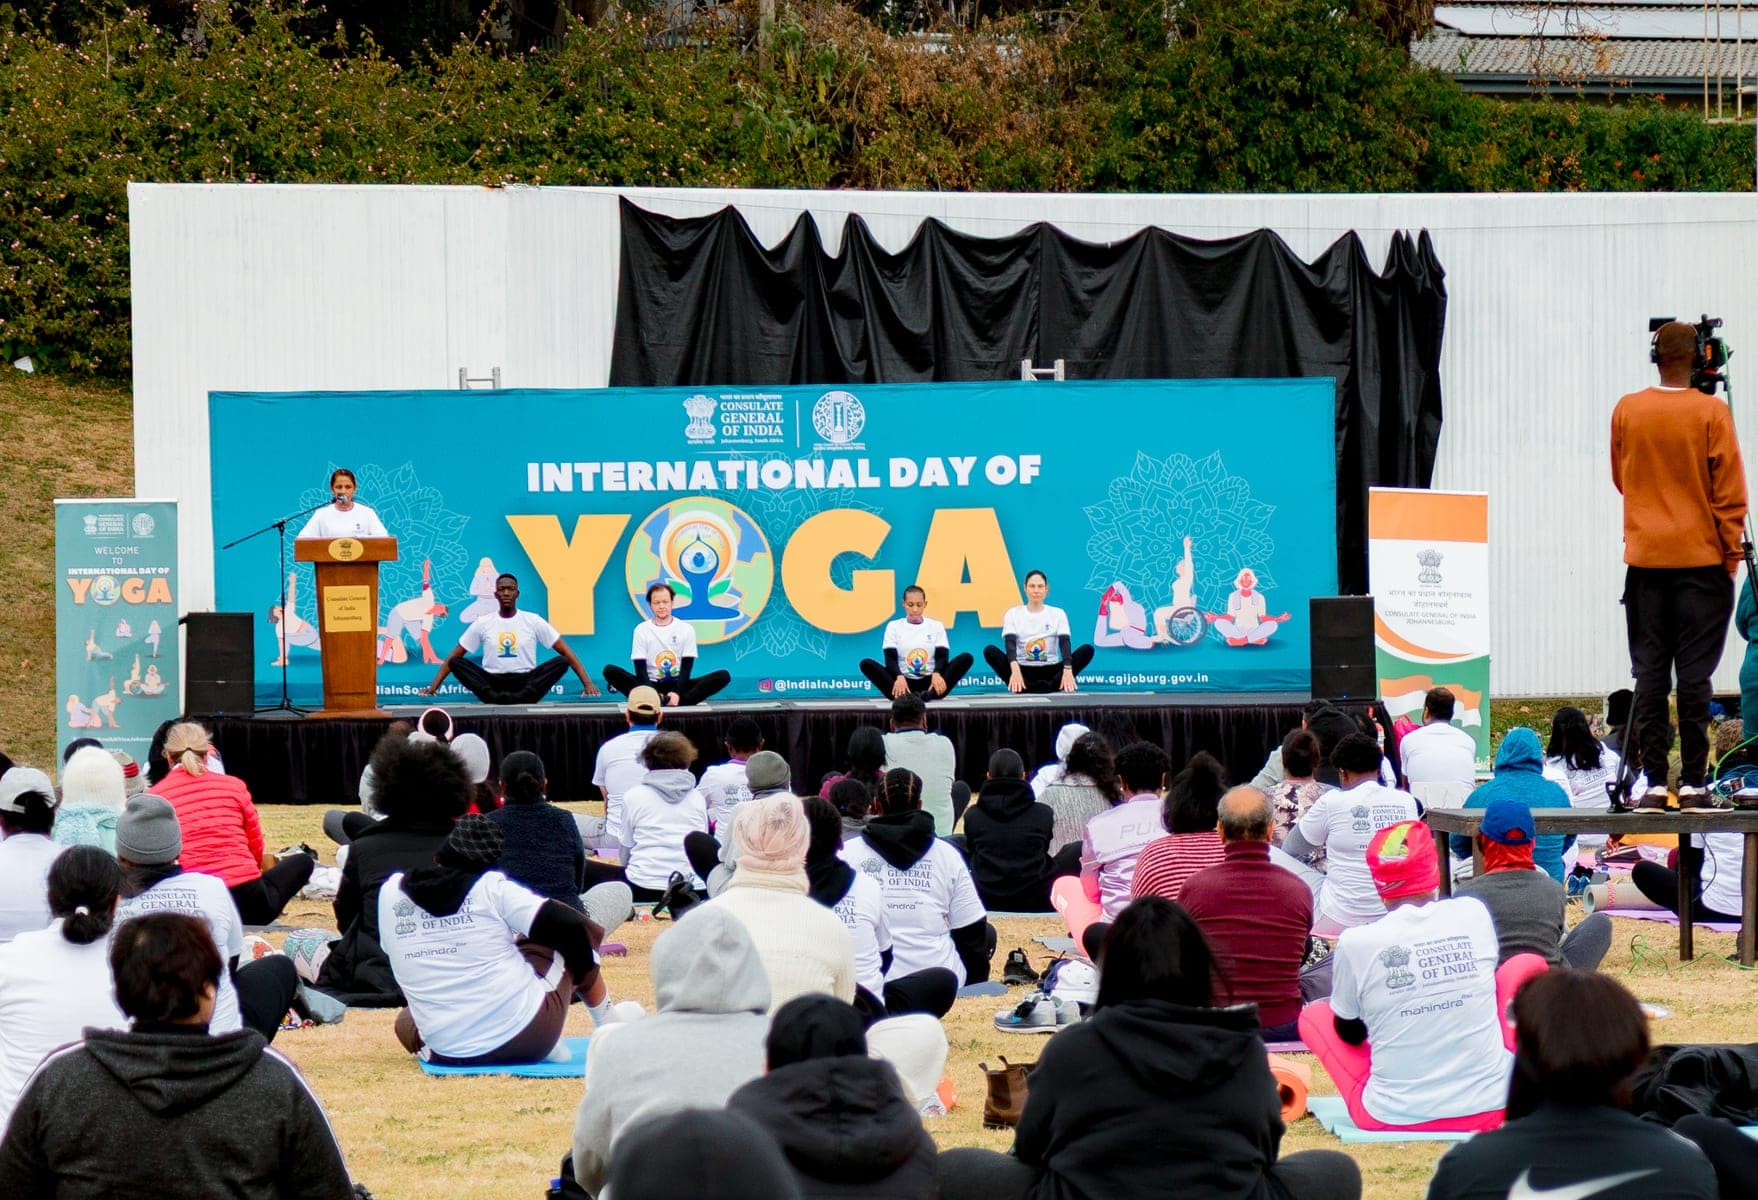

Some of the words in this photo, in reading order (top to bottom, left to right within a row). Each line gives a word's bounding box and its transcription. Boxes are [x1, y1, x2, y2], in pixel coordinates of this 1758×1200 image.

[720, 401, 784, 411] CONSULATE
[720, 412, 784, 424] GENERAL
[722, 425, 741, 436] OF
[743, 425, 784, 436] INDIA
[527, 458, 881, 492] INTERNATIONAL
[889, 456, 977, 488] DAY
[985, 454, 1041, 486] OF
[94, 546, 140, 555] WELCOME
[112, 557, 123, 565] TO
[68, 567, 138, 575] INTERNATIONAL
[139, 567, 157, 575] DAY
[1076, 672, 1209, 685] www.cgijoburg.gov.in
[775, 679, 872, 692] @IndiaInJoburg
[889, 878, 901, 886] OF
[904, 878, 931, 888] INDIA
[140, 892, 199, 900] CONSULATE
[141, 900, 201, 910] GENERAL
[422, 919, 437, 929] OF
[440, 915, 474, 928] INDIA
[405, 947, 458, 960] mahindra
[1416, 941, 1474, 957] CONSULATE
[1418, 951, 1476, 968] GENERAL
[1422, 968, 1439, 980] OF
[1443, 961, 1478, 976] INDIA
[1400, 999, 1464, 1017] mahindra
